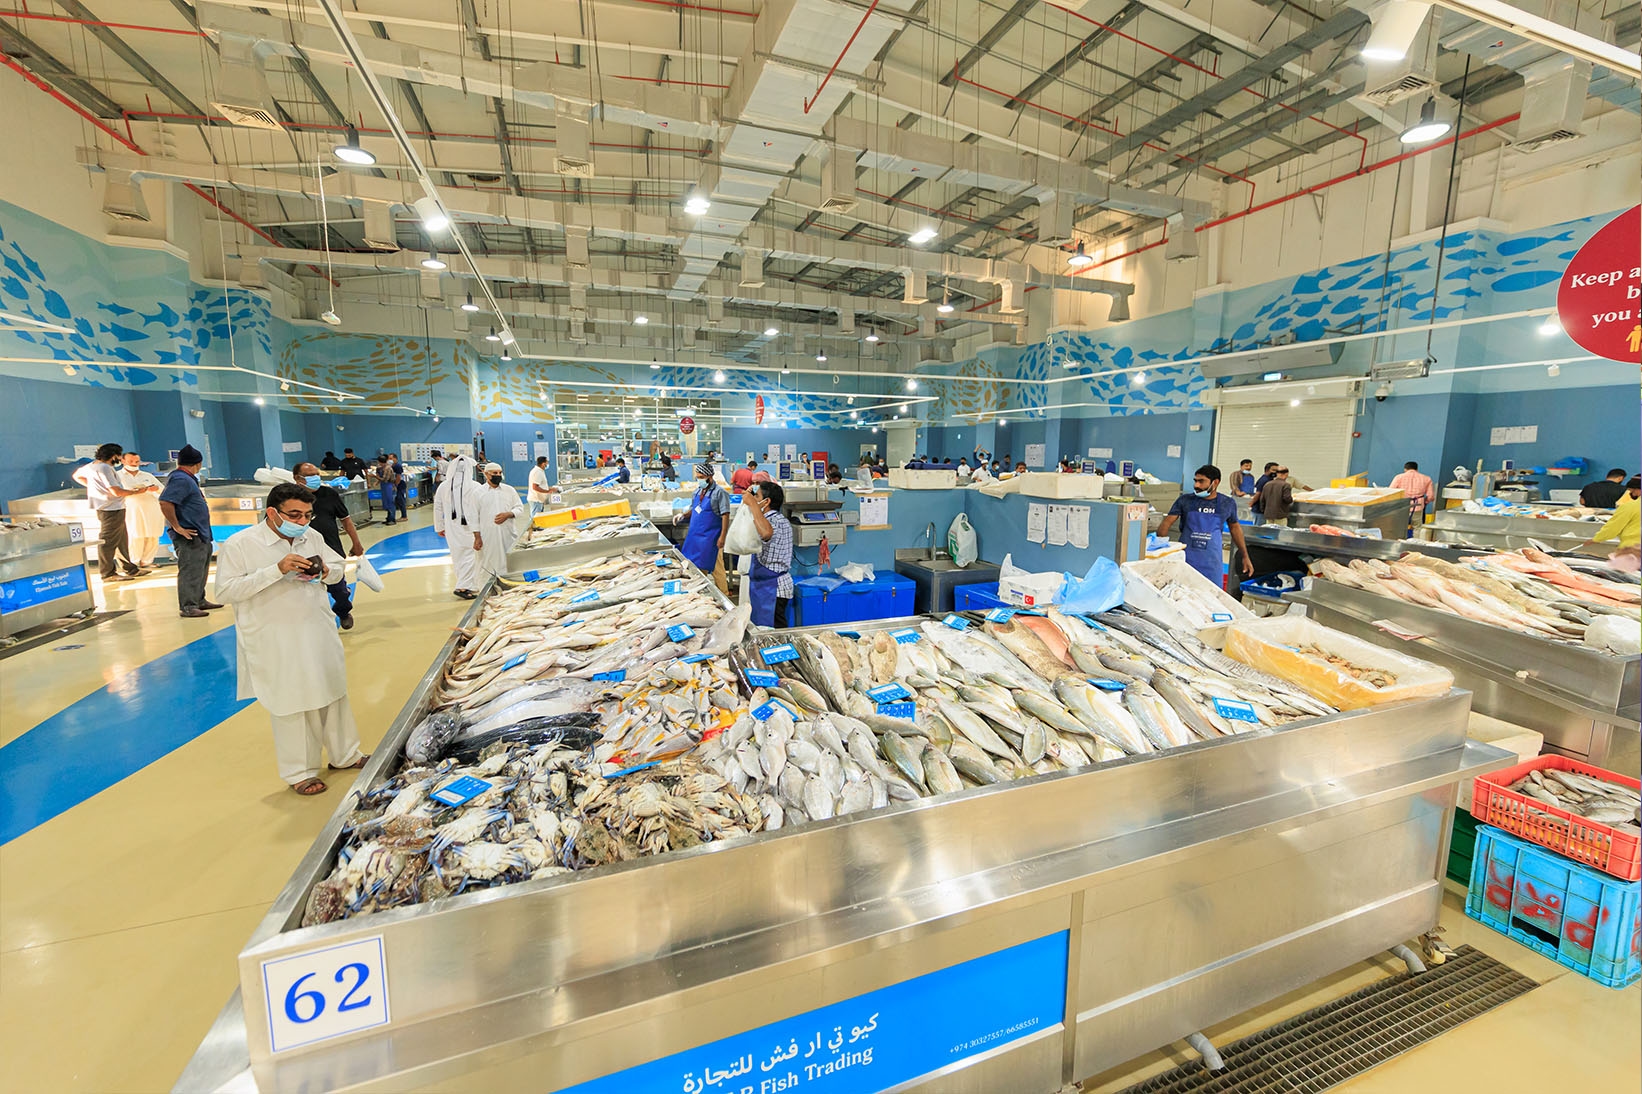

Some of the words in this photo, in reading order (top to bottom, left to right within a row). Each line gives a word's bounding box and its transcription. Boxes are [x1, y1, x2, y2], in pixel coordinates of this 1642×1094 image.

[1571, 270, 1623, 288] Keep
[1592, 310, 1631, 329] you
[71, 527, 82, 539] 59
[284, 962, 372, 1024] 62
[827, 1026, 844, 1054] تي
[848, 1012, 880, 1043] كيو
[760, 1038, 799, 1072] فش
[804, 1031, 822, 1058] ار
[949, 1042, 968, 1053] +974
[683, 1054, 753, 1094] للتجارة
[760, 1071, 799, 1094] Fish
[804, 1046, 874, 1081] Trading
